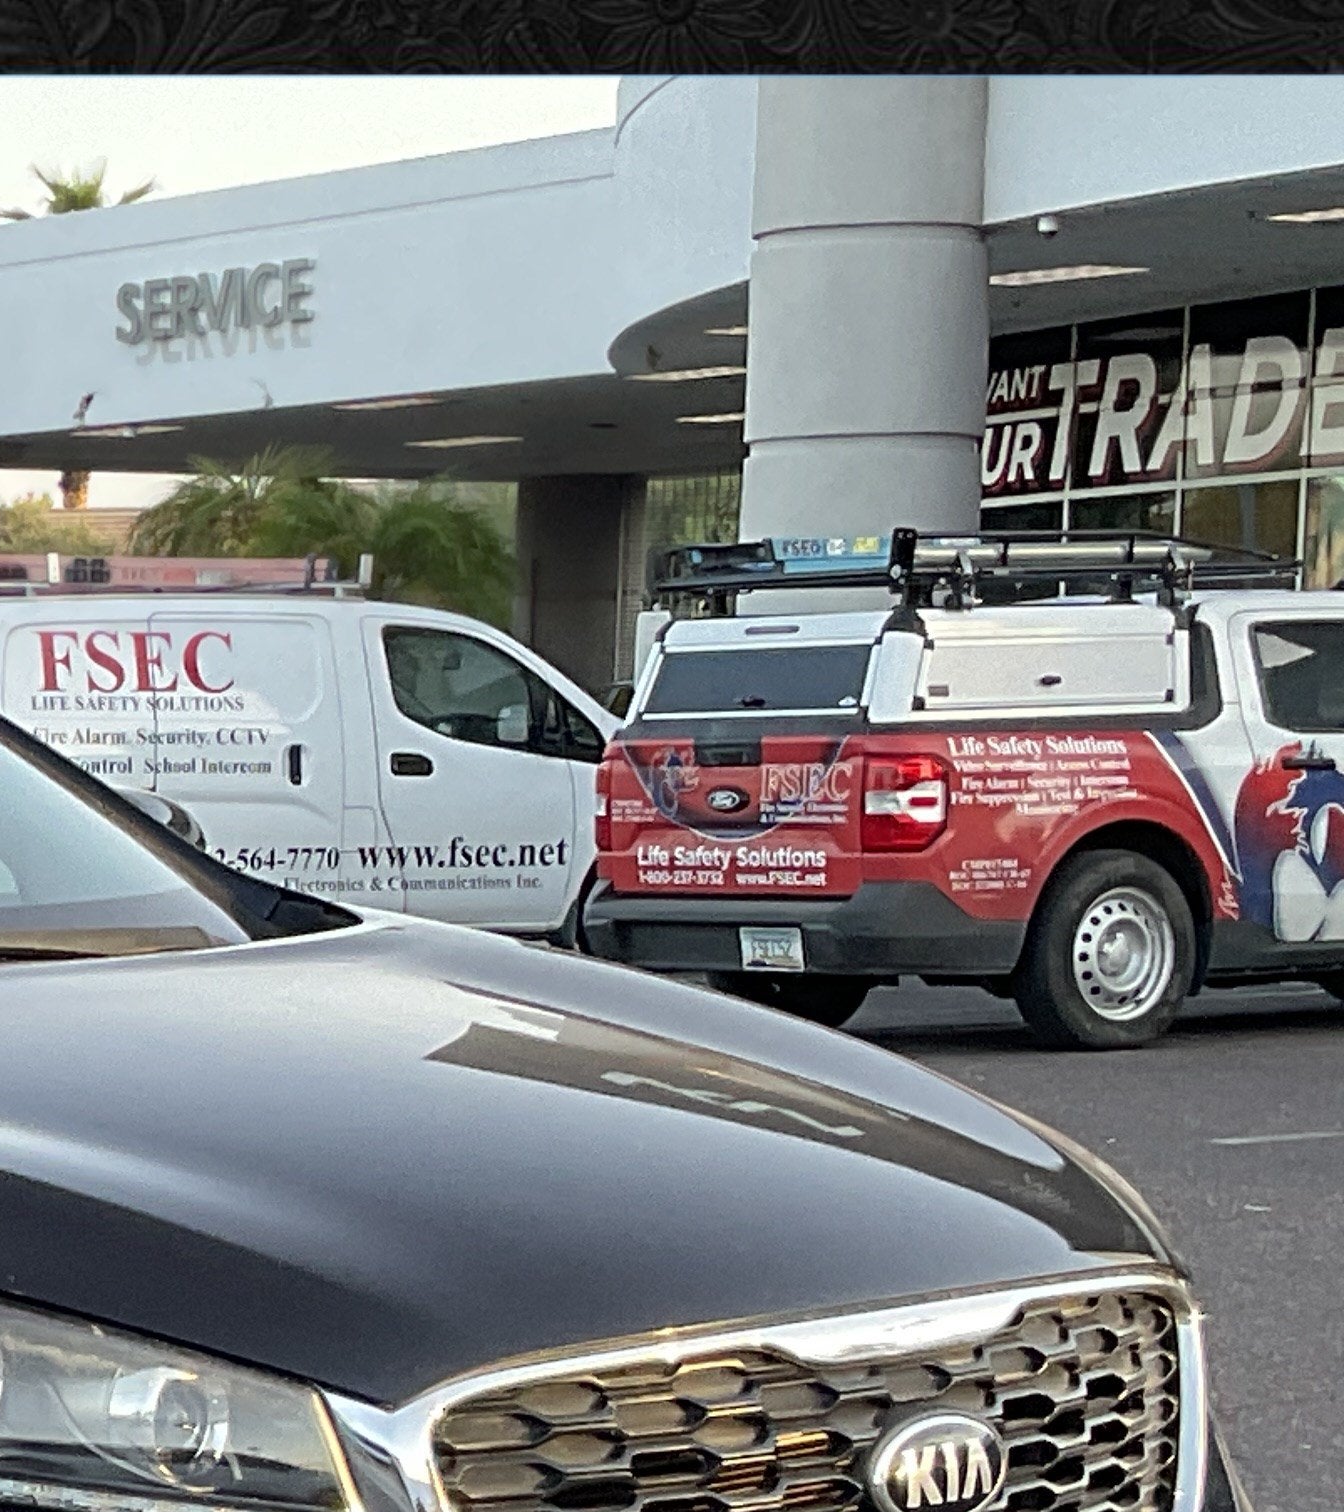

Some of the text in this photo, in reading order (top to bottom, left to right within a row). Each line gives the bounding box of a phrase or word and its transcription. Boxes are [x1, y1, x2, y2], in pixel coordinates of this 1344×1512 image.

[115, 257, 315, 345] SERVICE
[33, 631, 234, 693] FSEC
[31, 695, 244, 711] LIFE SAFETY SOLUTIONS
[216, 727, 269, 745] CCTV
[947, 735, 1127, 760] Life Safety Solutions
[71, 756, 272, 774] ontrol School Intercom
[759, 763, 853, 802] FSEC
[358, 837, 569, 869] www.fsec.net
[637, 846, 826, 870] Life Safety Solutions
[369, 876, 383, 891] &
[387, 874, 511, 891] Communications
[900, 1437, 993, 1509] KIA
